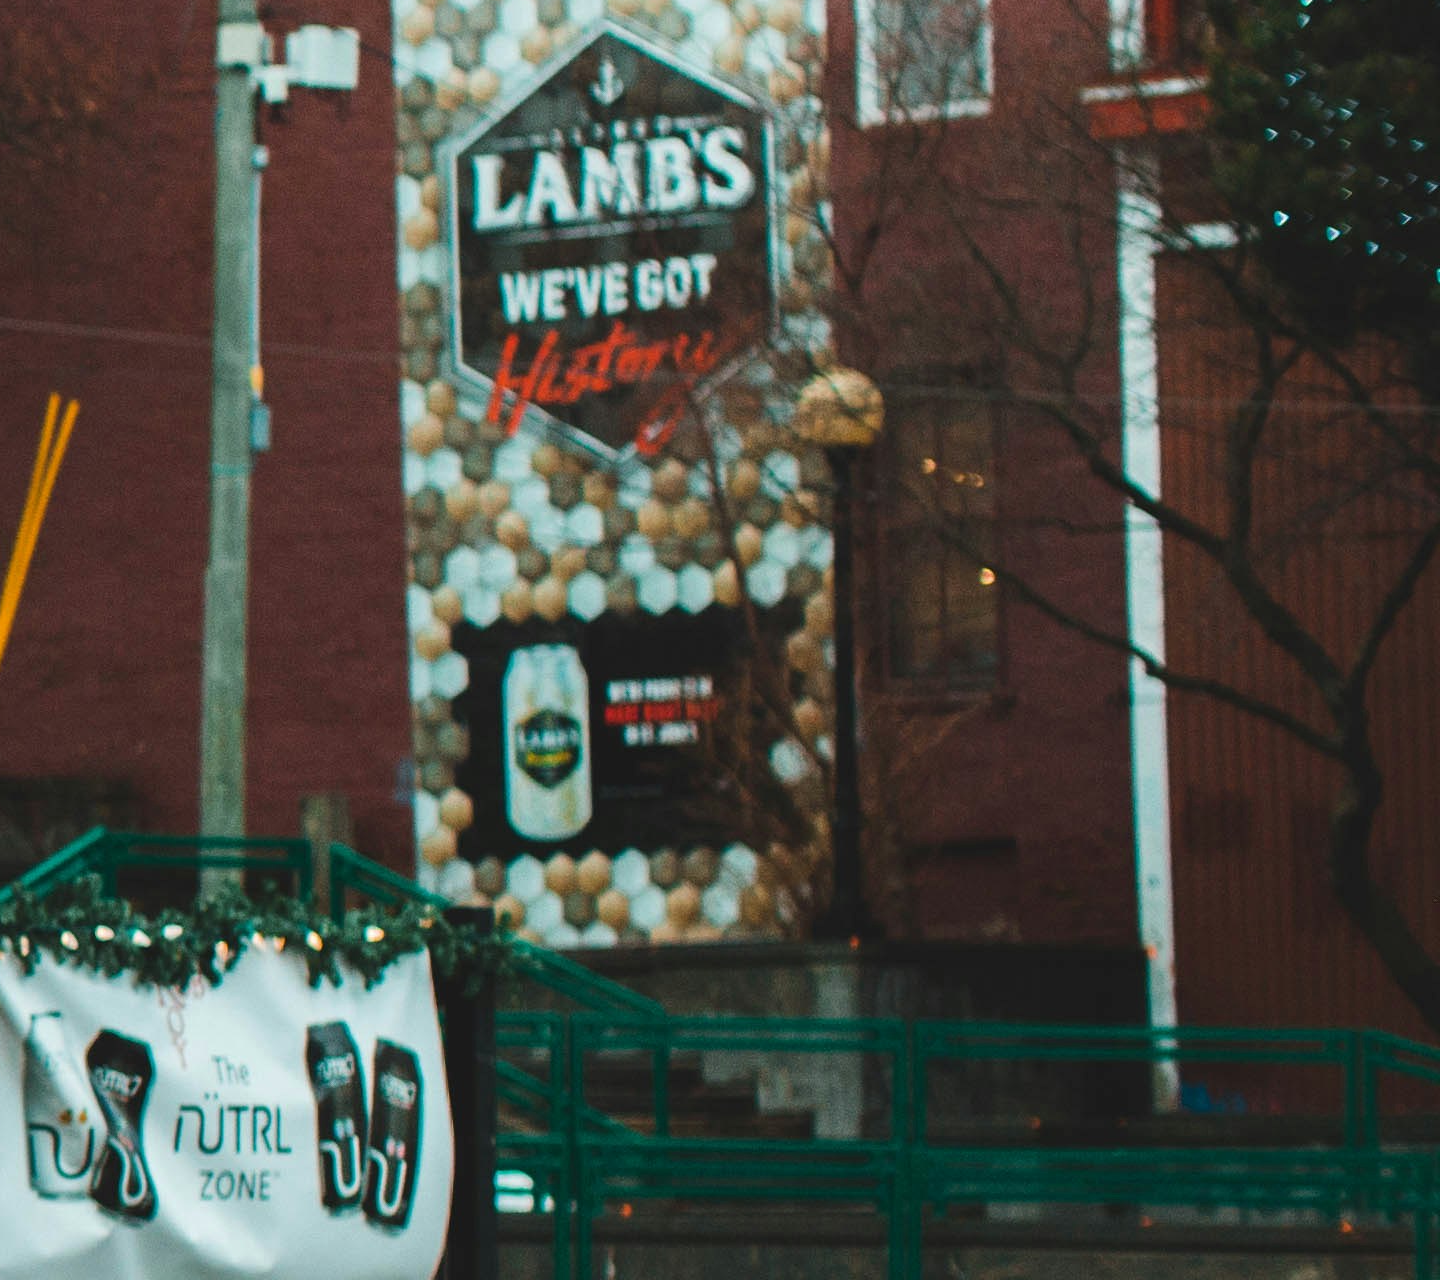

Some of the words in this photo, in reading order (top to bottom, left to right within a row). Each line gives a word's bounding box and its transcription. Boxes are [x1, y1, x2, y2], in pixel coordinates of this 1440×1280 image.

[500, 260, 629, 324] WE'VE
[634, 253, 718, 311] GOT
[485, 320, 725, 456] History
[212, 1056, 250, 1086] The
[200, 1170, 271, 1201] ZONE
